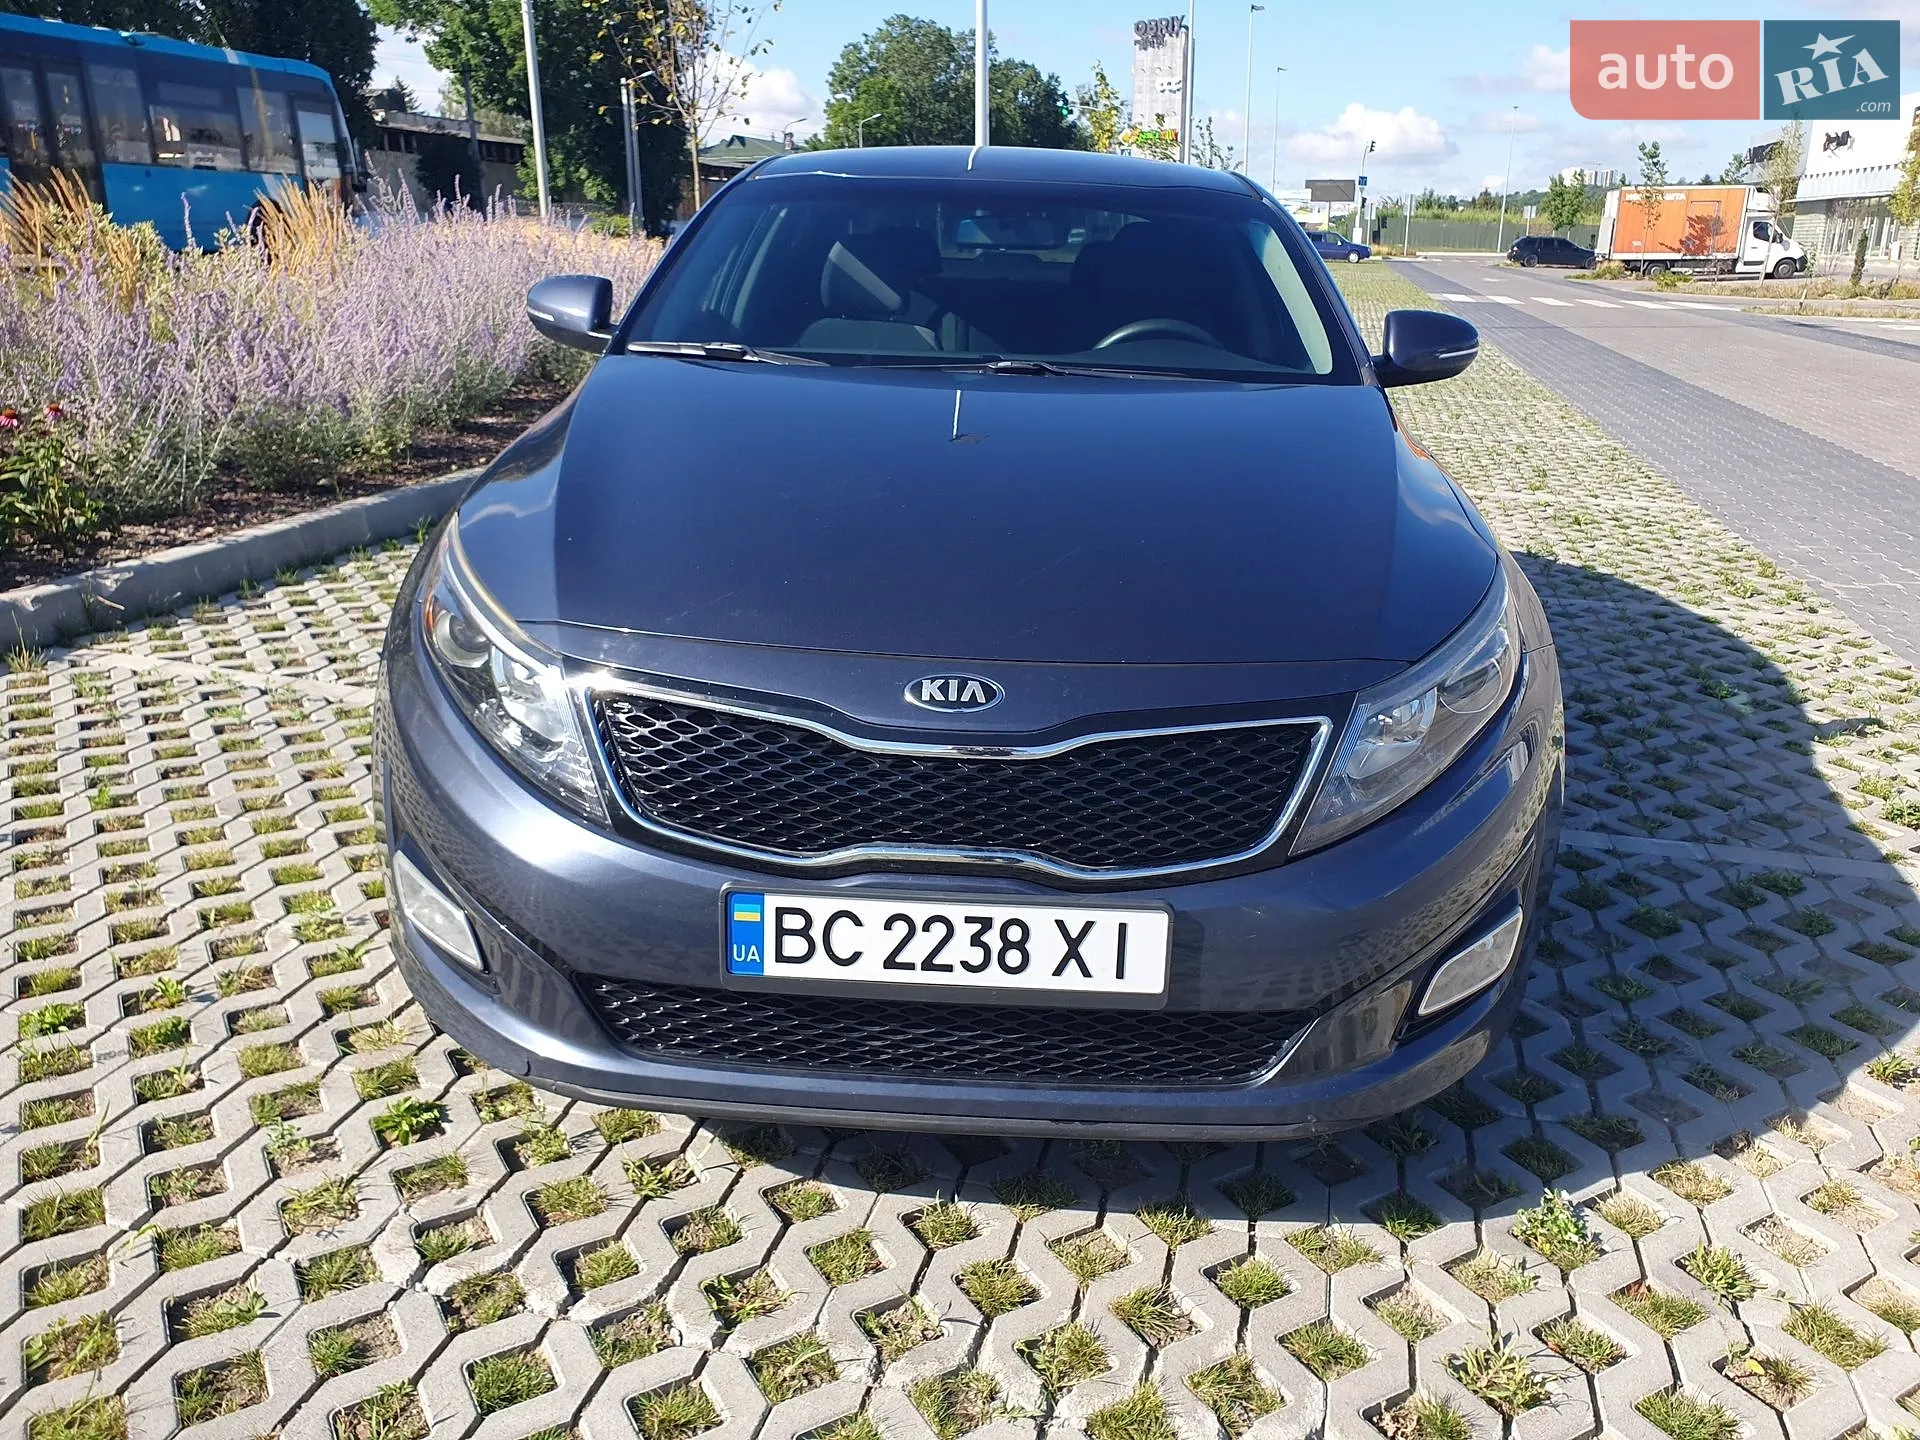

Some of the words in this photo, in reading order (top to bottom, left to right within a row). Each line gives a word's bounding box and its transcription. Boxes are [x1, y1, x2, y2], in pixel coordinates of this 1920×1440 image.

[921, 679, 986, 703] KIA
[774, 906, 864, 967] BC
[883, 912, 1031, 976] 2238
[732, 944, 761, 963] UA
